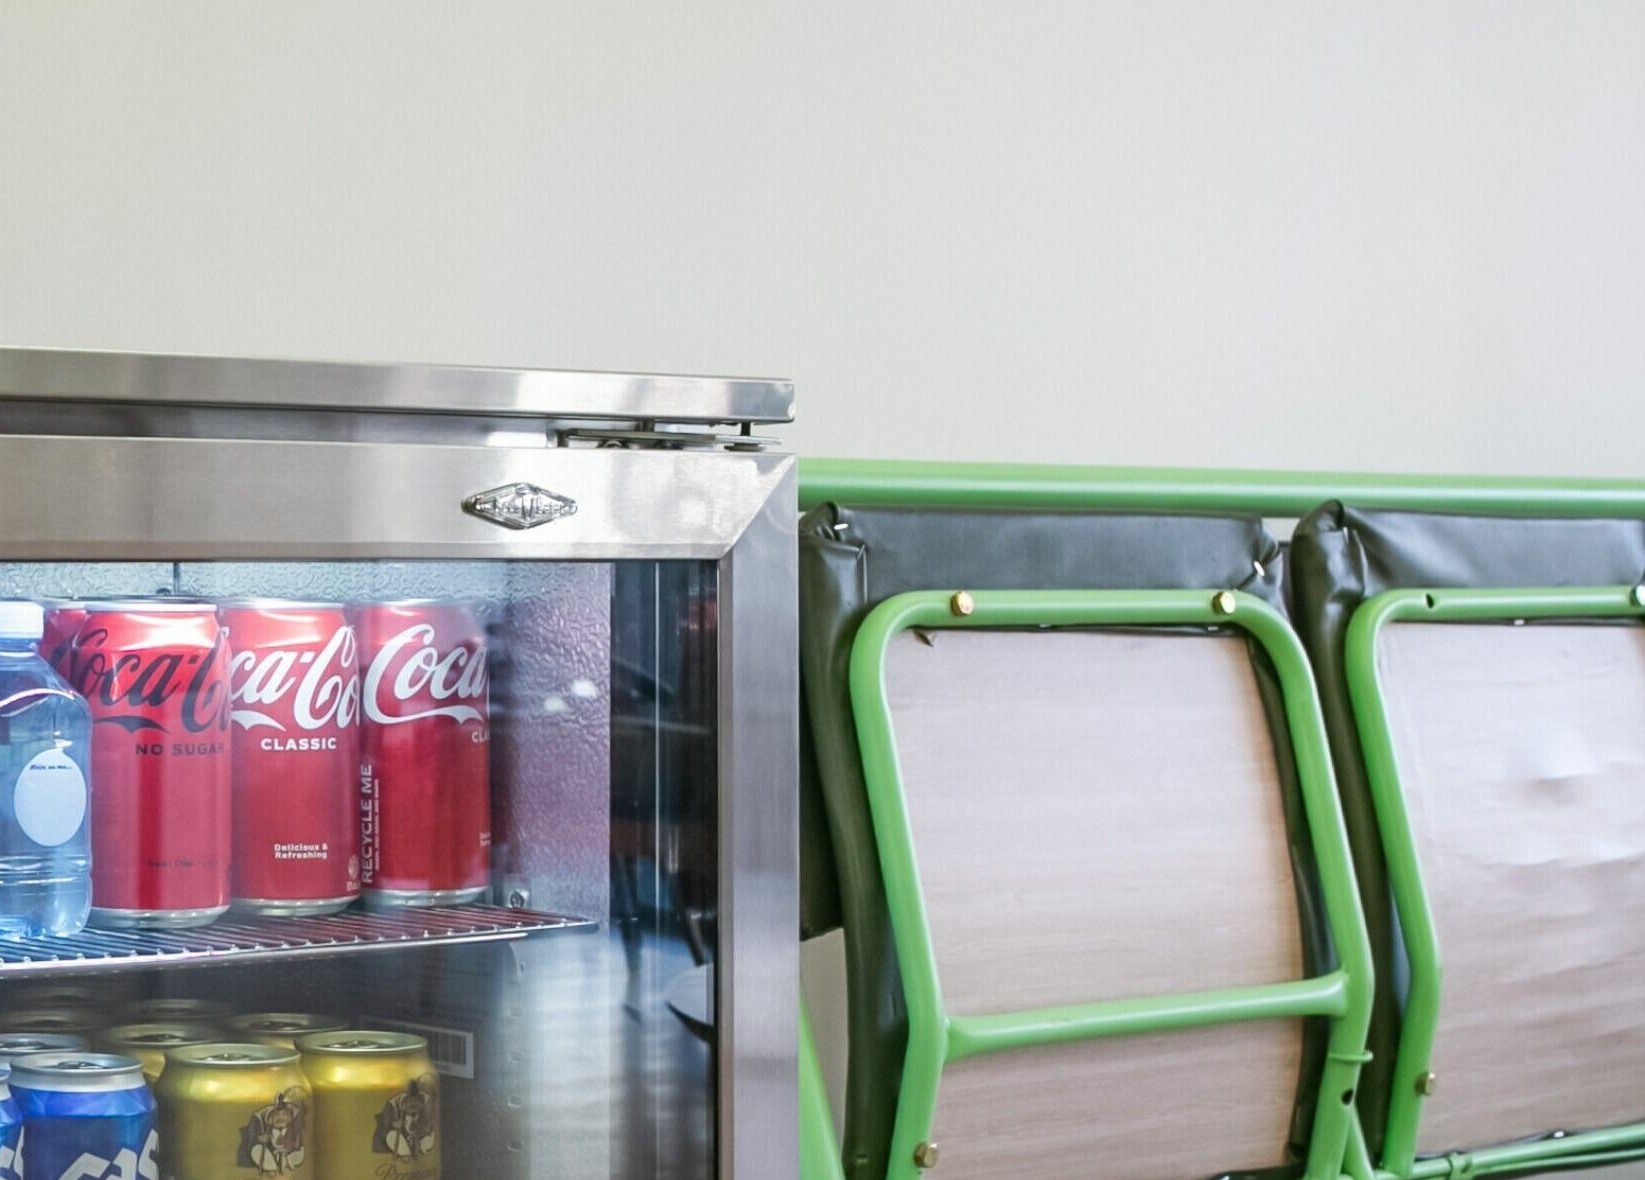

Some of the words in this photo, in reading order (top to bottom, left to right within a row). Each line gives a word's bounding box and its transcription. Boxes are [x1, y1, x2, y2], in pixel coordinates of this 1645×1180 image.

[135, 744, 164, 756] NO
[260, 737, 337, 751] CLASSIC
[360, 763, 373, 794] ME
[361, 799, 373, 884] RECYCLE
